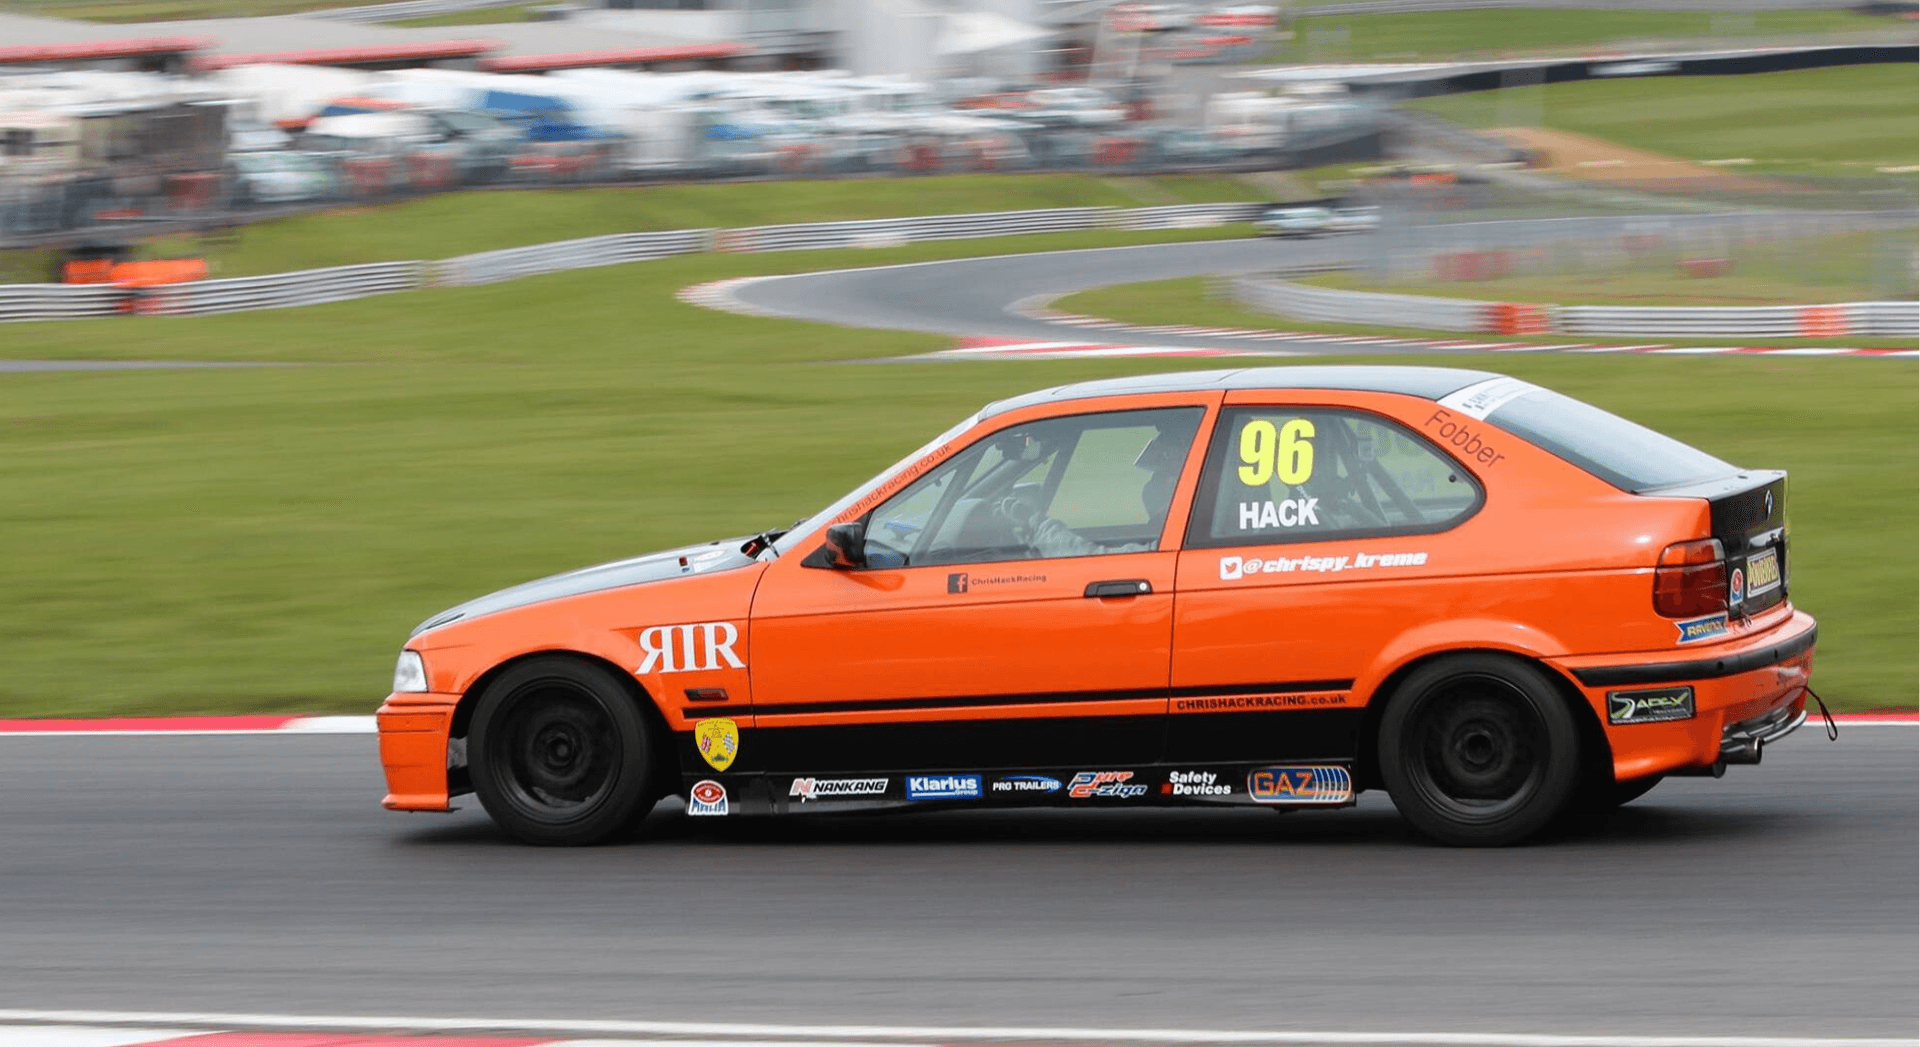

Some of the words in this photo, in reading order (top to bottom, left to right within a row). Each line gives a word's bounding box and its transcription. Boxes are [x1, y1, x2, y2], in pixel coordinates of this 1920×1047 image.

[1424, 409, 1505, 467] Fobber
[1238, 418, 1316, 487] 96
[1239, 498, 1319, 529] HACK
[1243, 552, 1428, 574] @chrispy_kreme
[1177, 694, 1346, 710] CHRISHACKRACING.co.uk
[910, 777, 977, 791] Klarius
[993, 782, 1011, 791] PRO
[1014, 781, 1059, 790] TRAILERS
[1169, 771, 1217, 785] Safety
[1254, 772, 1313, 795] GAZ
[814, 780, 888, 794] NANKANG
[1173, 783, 1231, 795] Devices
